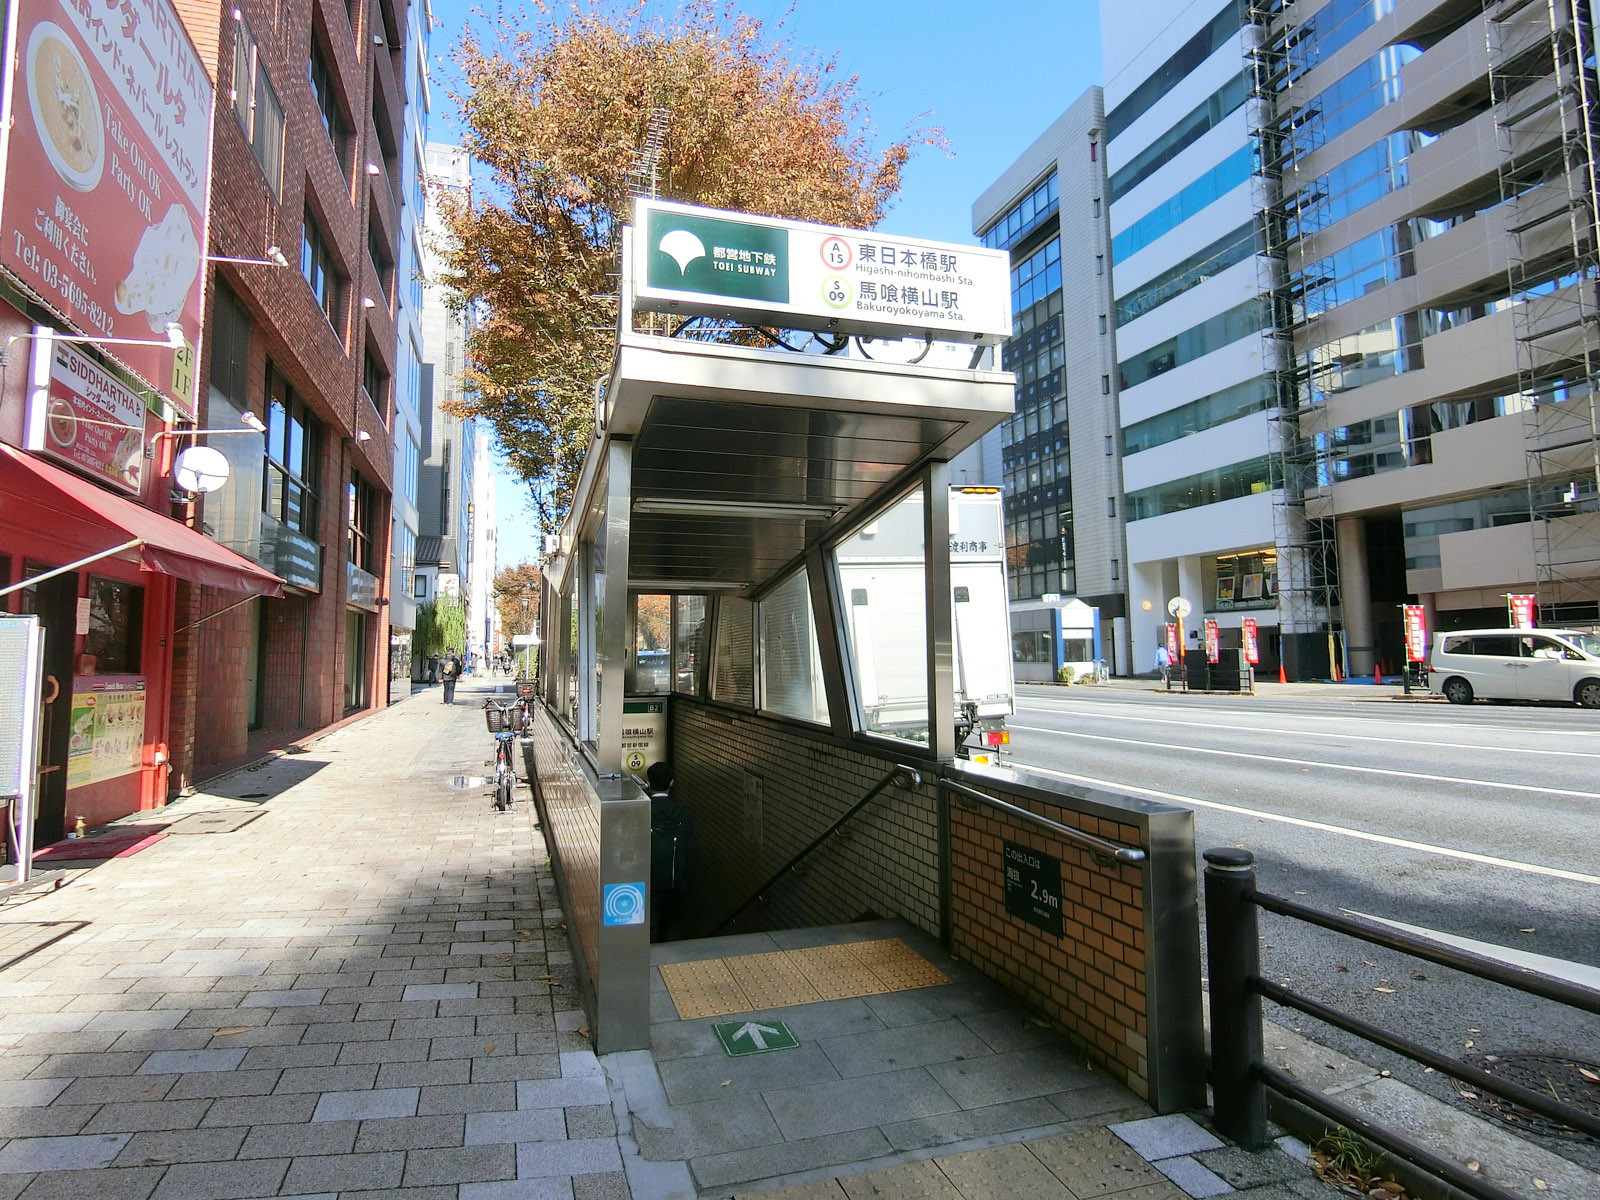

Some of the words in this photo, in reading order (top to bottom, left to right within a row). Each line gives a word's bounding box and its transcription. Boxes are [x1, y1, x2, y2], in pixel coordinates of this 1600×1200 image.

[105, 103, 129, 154] Take
[130, 142, 147, 180] Out
[149, 167, 162, 201] OK
[111, 151, 137, 203] Party
[138, 189, 153, 222] OK
[13, 229, 39, 274] Tel:
[713, 246, 777, 266] 都営地下鉄
[830, 252, 844, 264] 15
[832, 243, 840, 252] A
[859, 243, 958, 274] 東日本橋駅
[713, 260, 734, 272] TOEI
[737, 263, 777, 277] SUBWAY
[855, 263, 956, 284] Higashi-nihombashi
[957, 275, 976, 287] Sta.
[829, 290, 845, 302] 09
[833, 280, 840, 290] S
[859, 280, 959, 310] 馬喰横山駅
[856, 300, 945, 319] Bakuroyokoyama
[947, 310, 966, 322] Sta.
[69, 357, 135, 416] SIDDHARTHA
[1030, 879, 1058, 909] 2.9m
